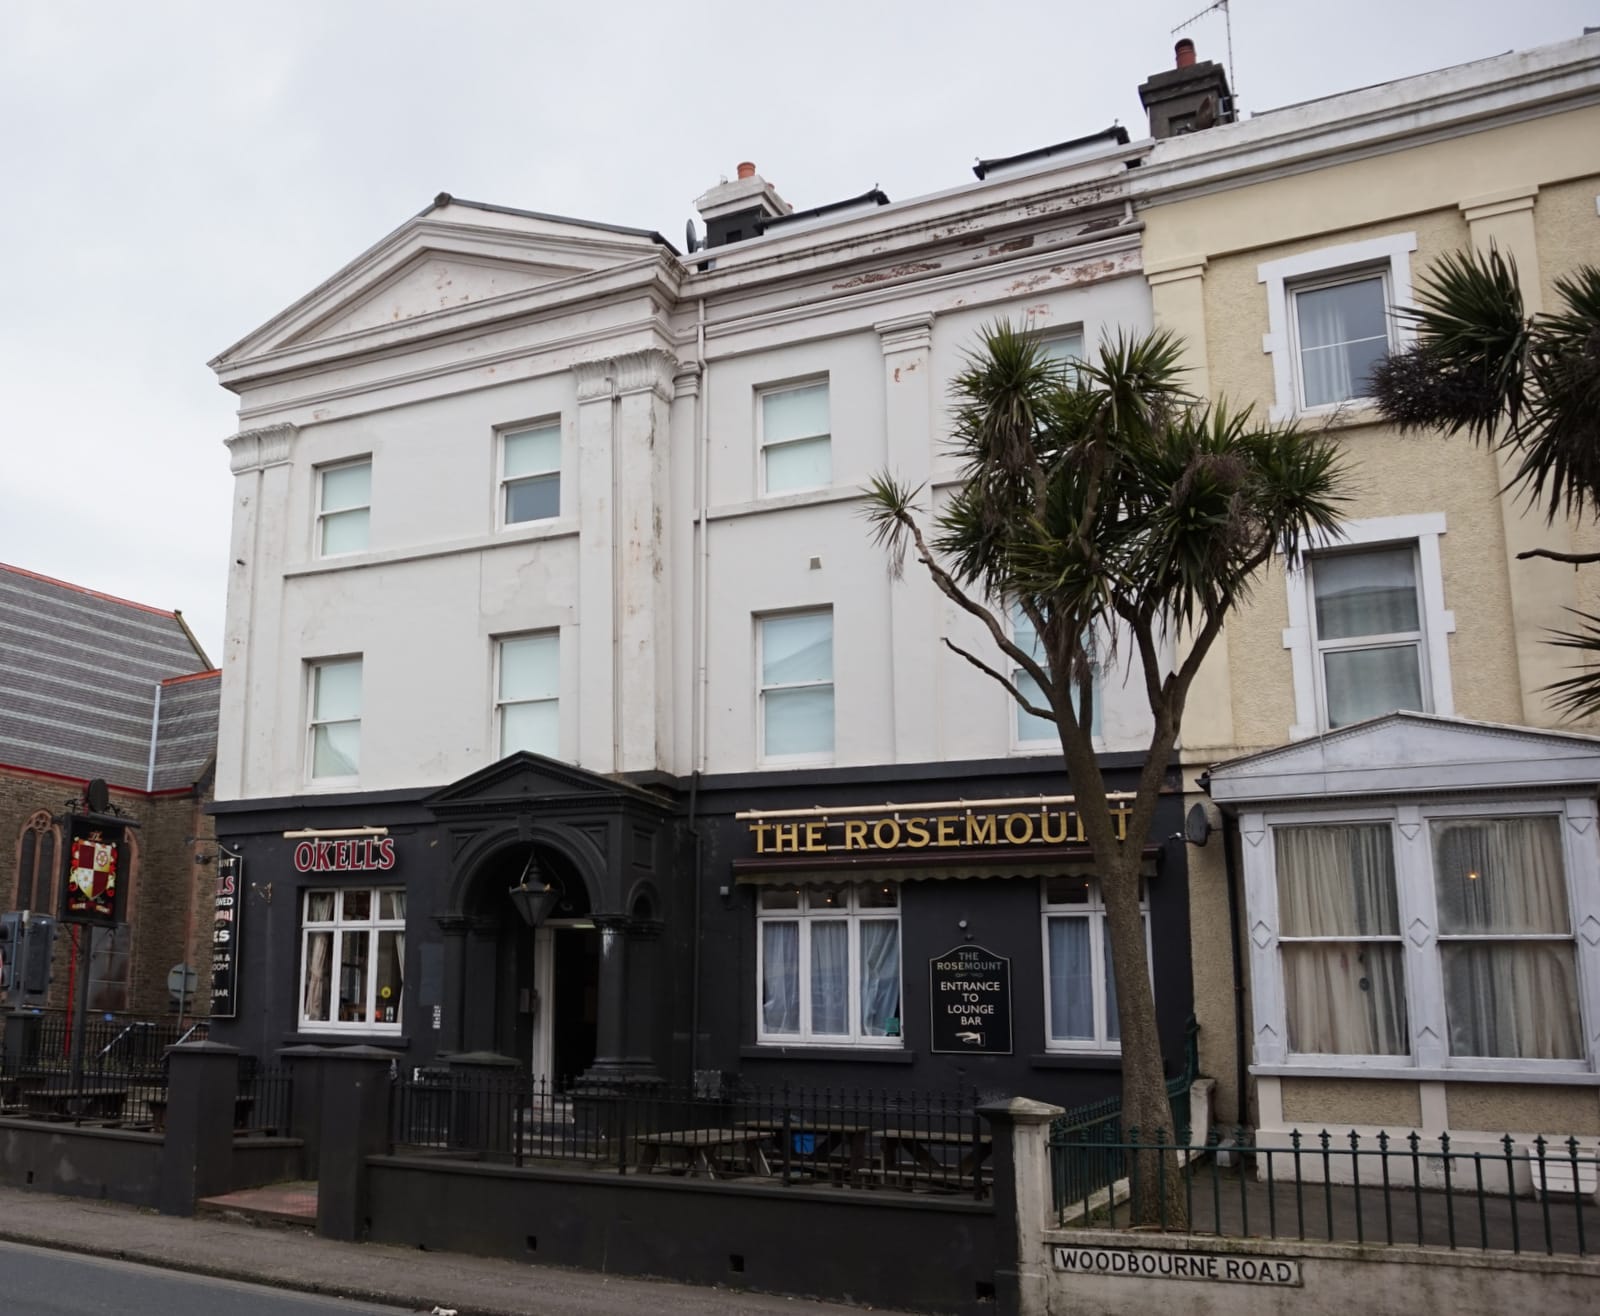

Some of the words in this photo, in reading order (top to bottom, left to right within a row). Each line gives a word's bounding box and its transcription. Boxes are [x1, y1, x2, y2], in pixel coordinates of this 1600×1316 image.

[749, 821, 828, 853] THE
[294, 838, 395, 872] OKELLS
[959, 952, 979, 961] THE
[937, 961, 1002, 971] ROSEMOUNT
[940, 981, 1000, 991] ENTRANCE
[962, 993, 979, 1003] TO
[947, 1004, 995, 1015] LOUNGE
[961, 1016, 983, 1026] BAR
[1061, 1249, 1219, 1278] WOODBOURNE
[1226, 1259, 1292, 1283] ROAD
